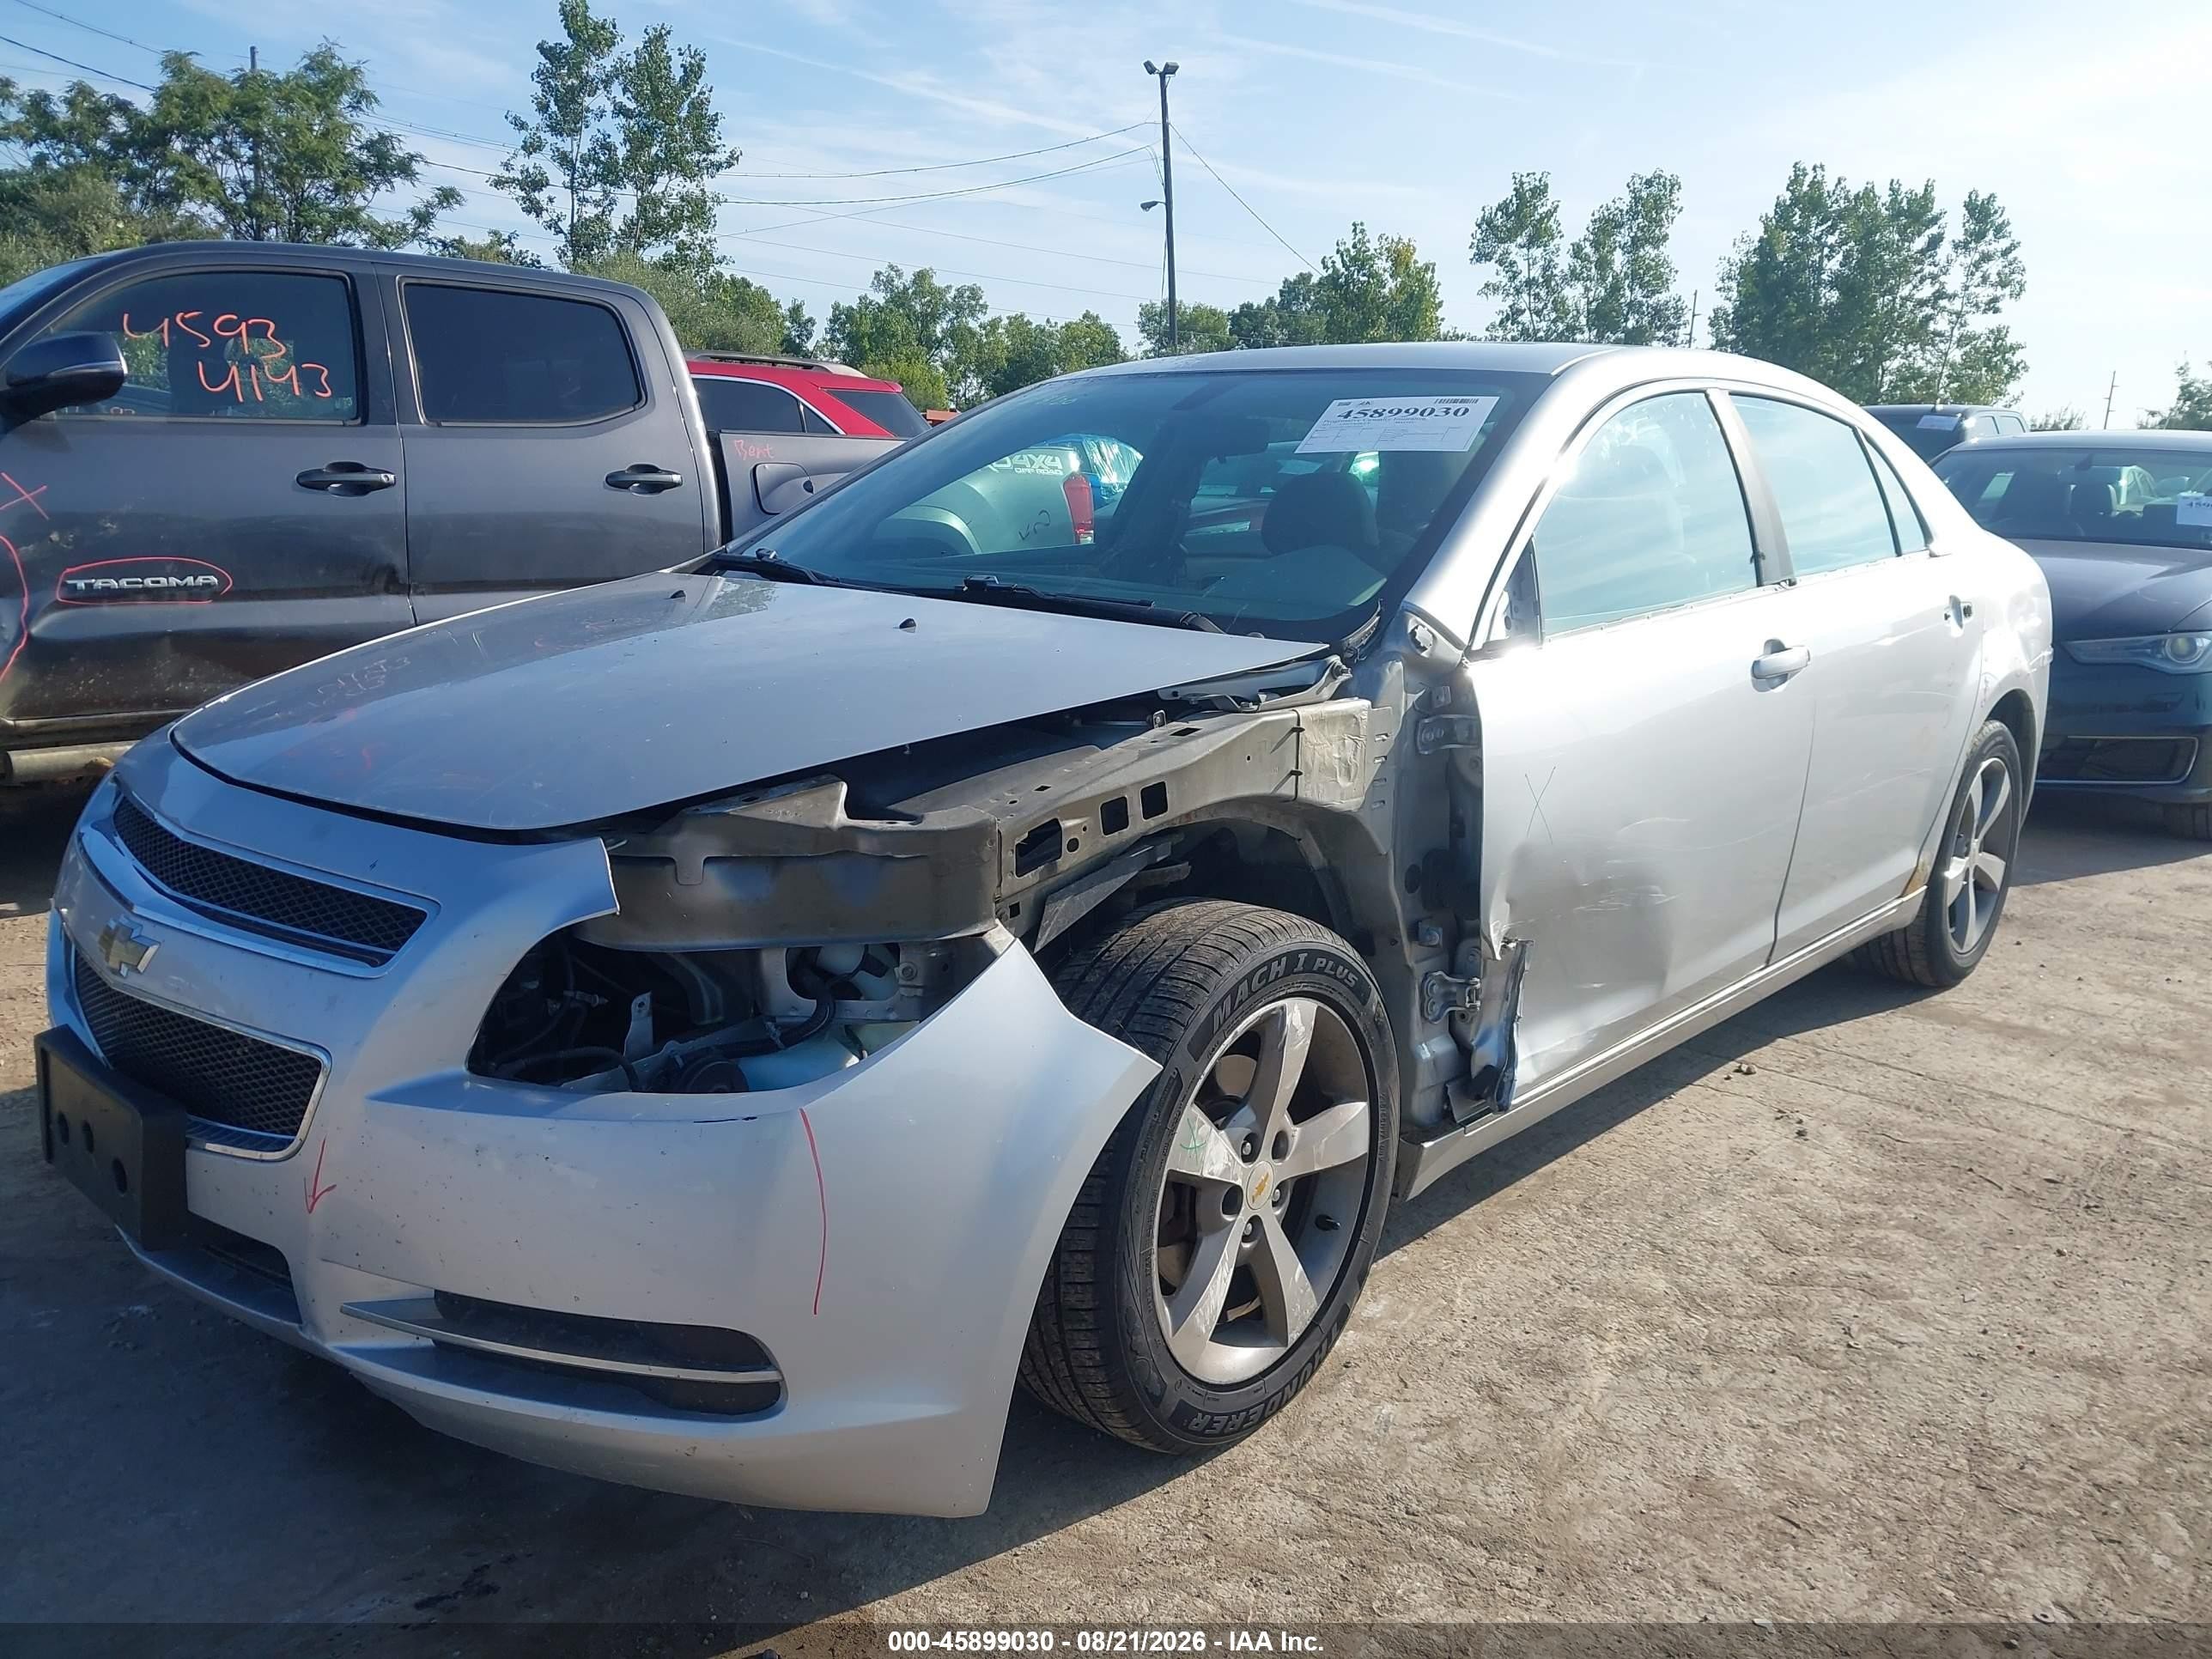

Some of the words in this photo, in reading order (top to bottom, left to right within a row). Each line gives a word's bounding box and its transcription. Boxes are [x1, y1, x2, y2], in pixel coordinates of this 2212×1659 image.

[123, 311, 287, 360] 4593
[198, 361, 332, 404] 4143
[1337, 406, 1469, 420] 45899030
[65, 574, 219, 591] TACOMA
[1212, 957, 1287, 1032] MACH
[1313, 957, 1359, 988] PLUS
